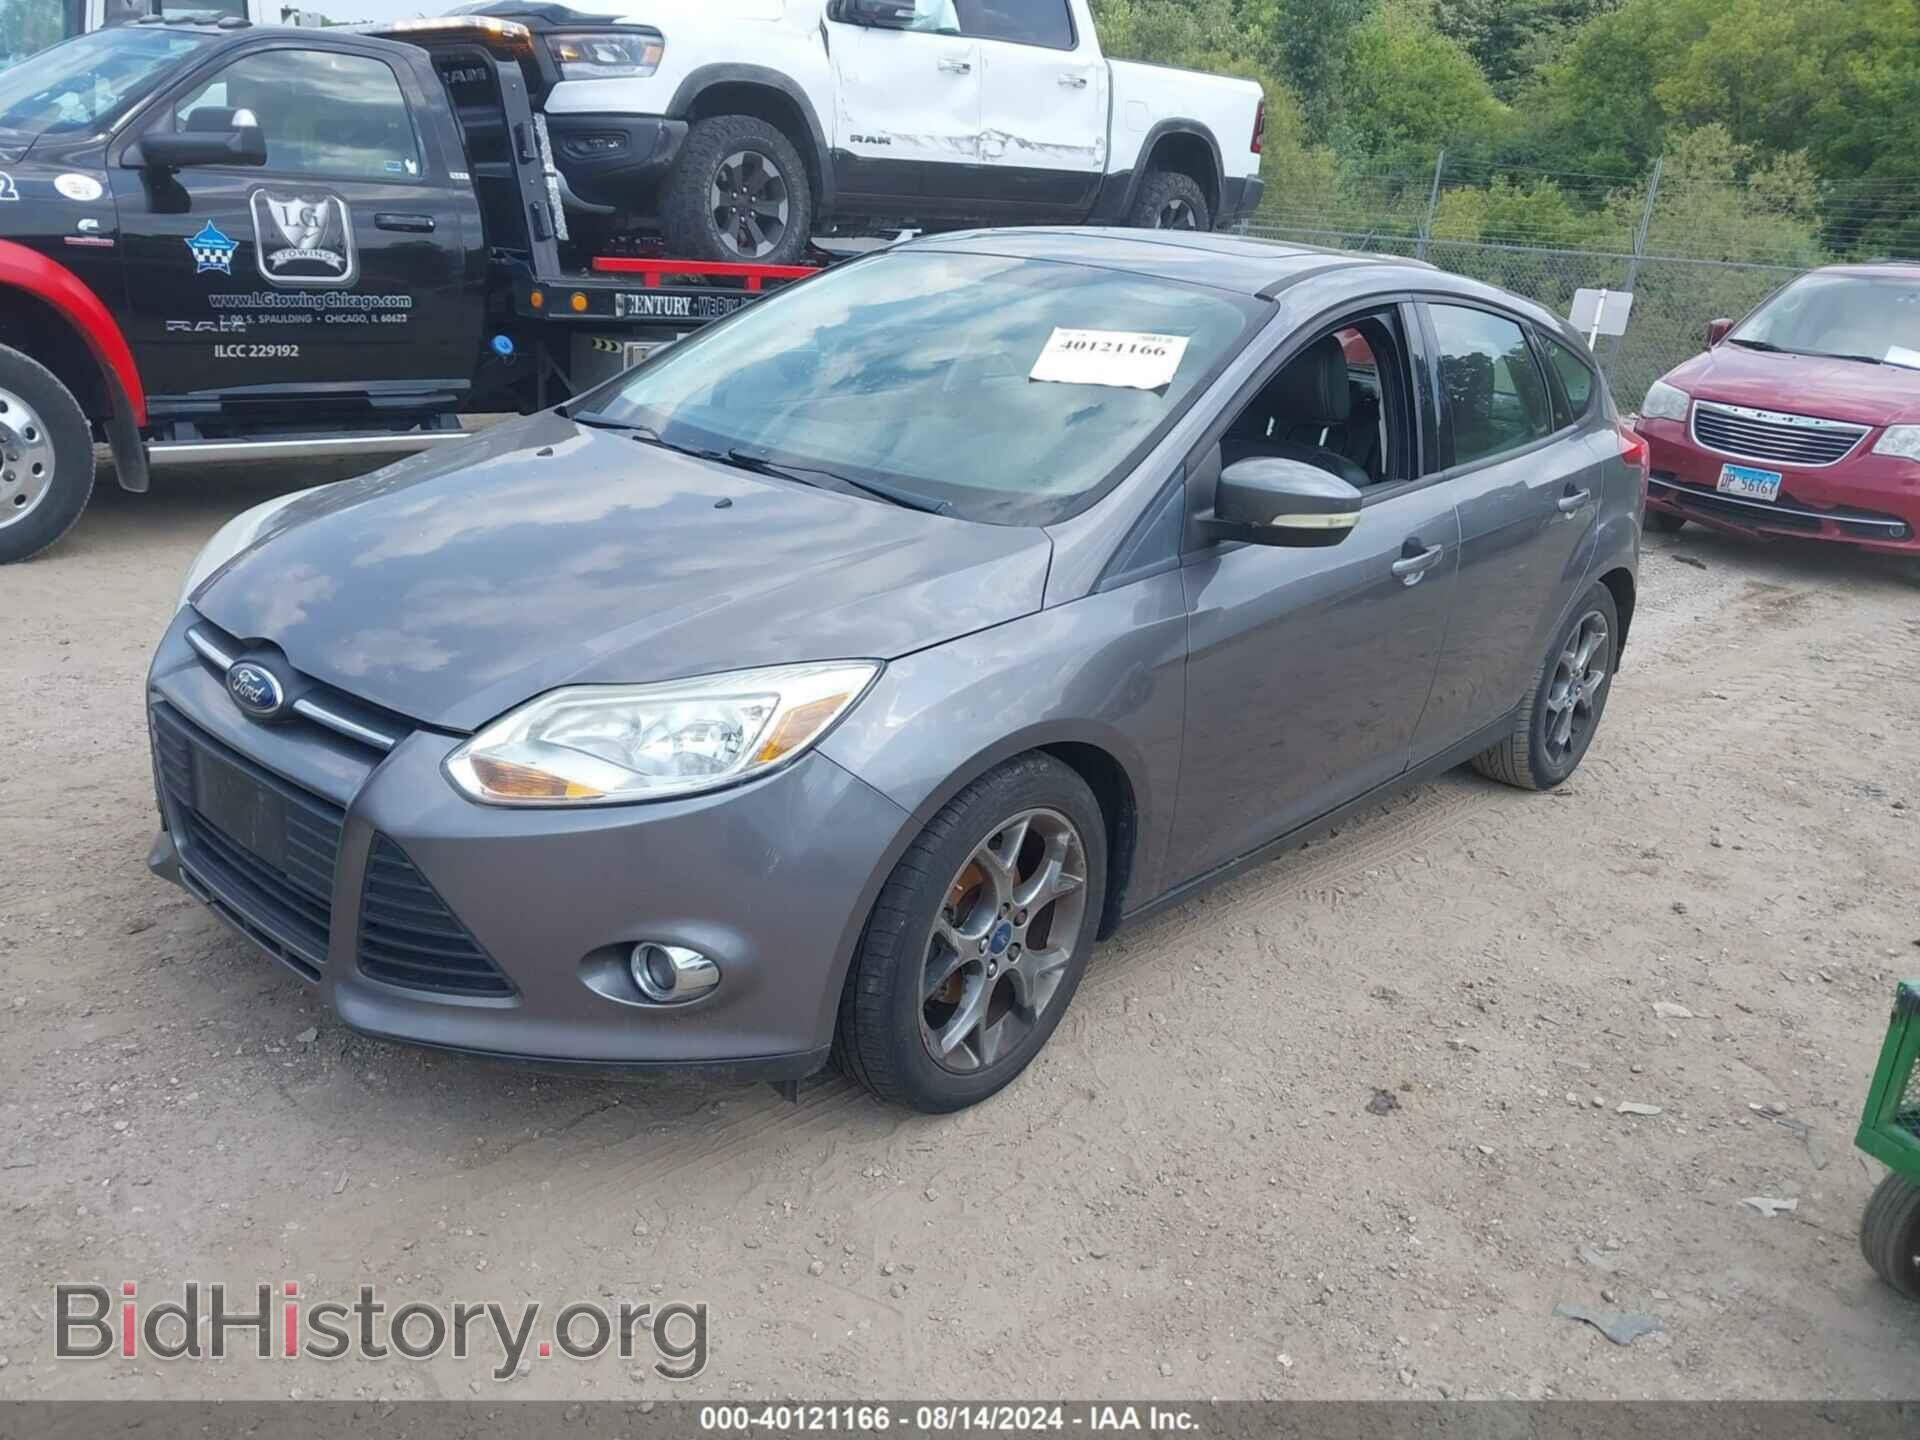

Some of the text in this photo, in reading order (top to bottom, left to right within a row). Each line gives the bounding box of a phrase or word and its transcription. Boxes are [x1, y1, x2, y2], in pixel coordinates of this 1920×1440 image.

[850, 134, 891, 145] RAM
[281, 205, 320, 228] LG
[281, 249, 333, 260] TOWING
[208, 292, 412, 310] www.LGtowingChicago.com
[324, 314, 369, 324] CHICAGO,
[214, 344, 299, 357] ILCC 229192
[1060, 340, 1166, 356] 40121166
[233, 669, 265, 702] Ford
